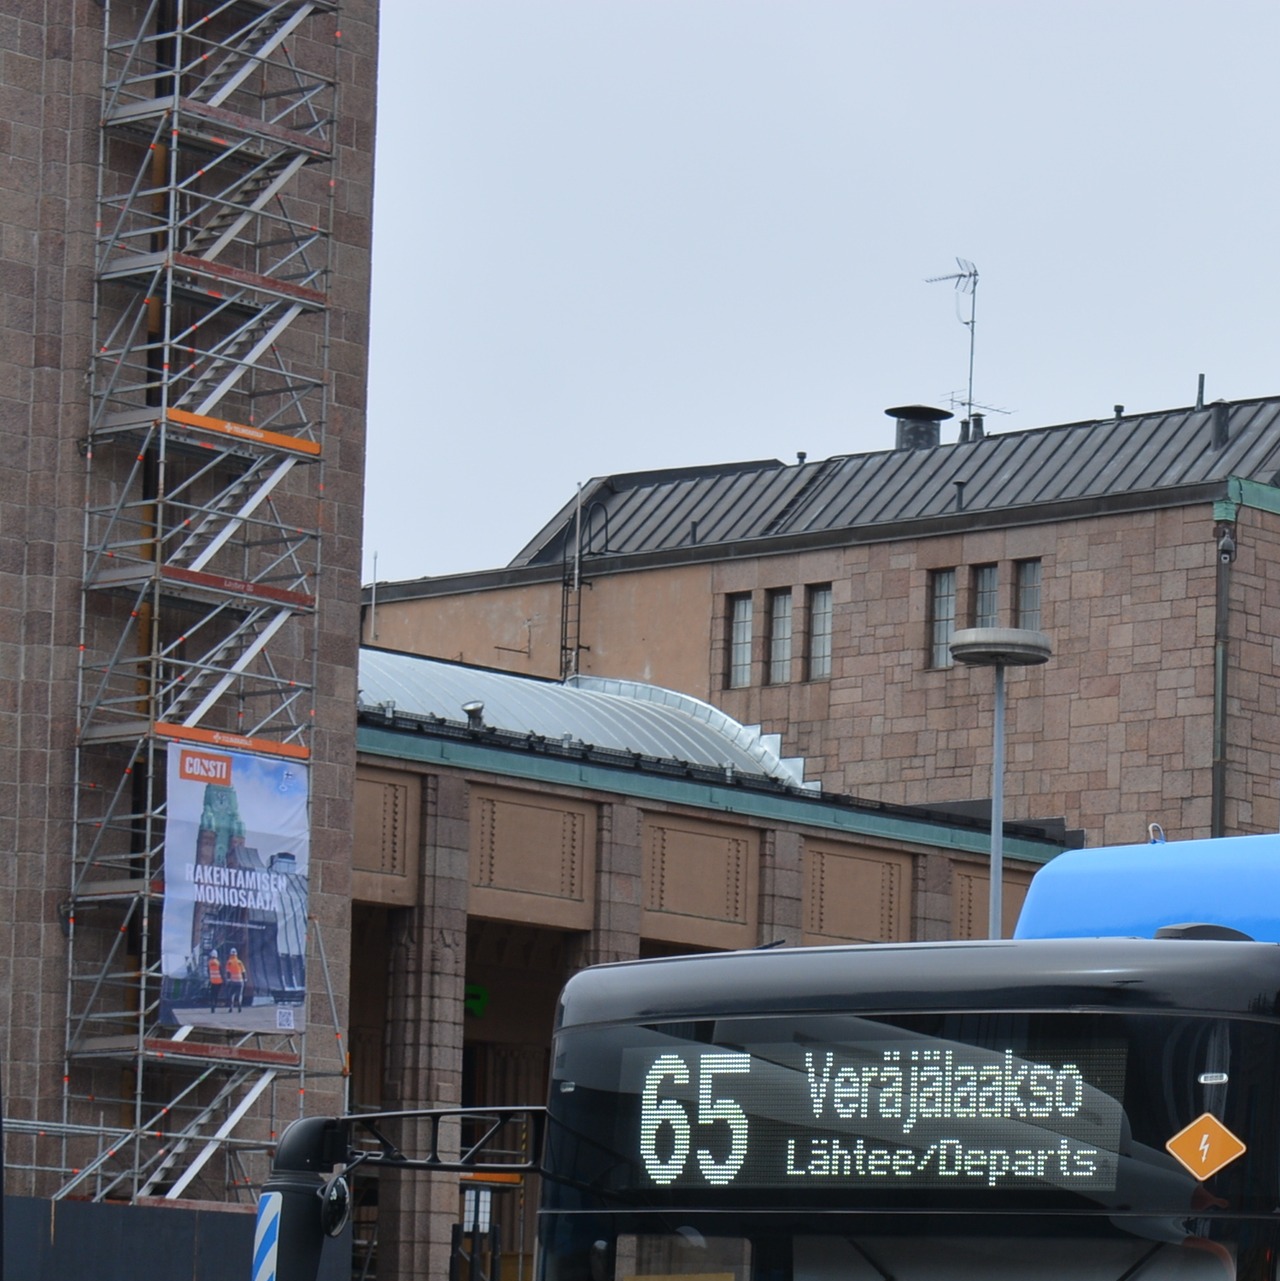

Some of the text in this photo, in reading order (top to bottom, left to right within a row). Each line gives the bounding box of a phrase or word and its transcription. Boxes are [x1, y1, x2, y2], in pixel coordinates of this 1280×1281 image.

[185, 756, 227, 779] CONSTI
[185, 863, 287, 892] RAKENTAMISEN
[194, 884, 279, 912] MONIOSAAJA
[804, 1049, 1084, 1133] Veräjälaakso
[640, 1054, 751, 1184] 65
[787, 1139, 1097, 1186] Lähtee/Departs
